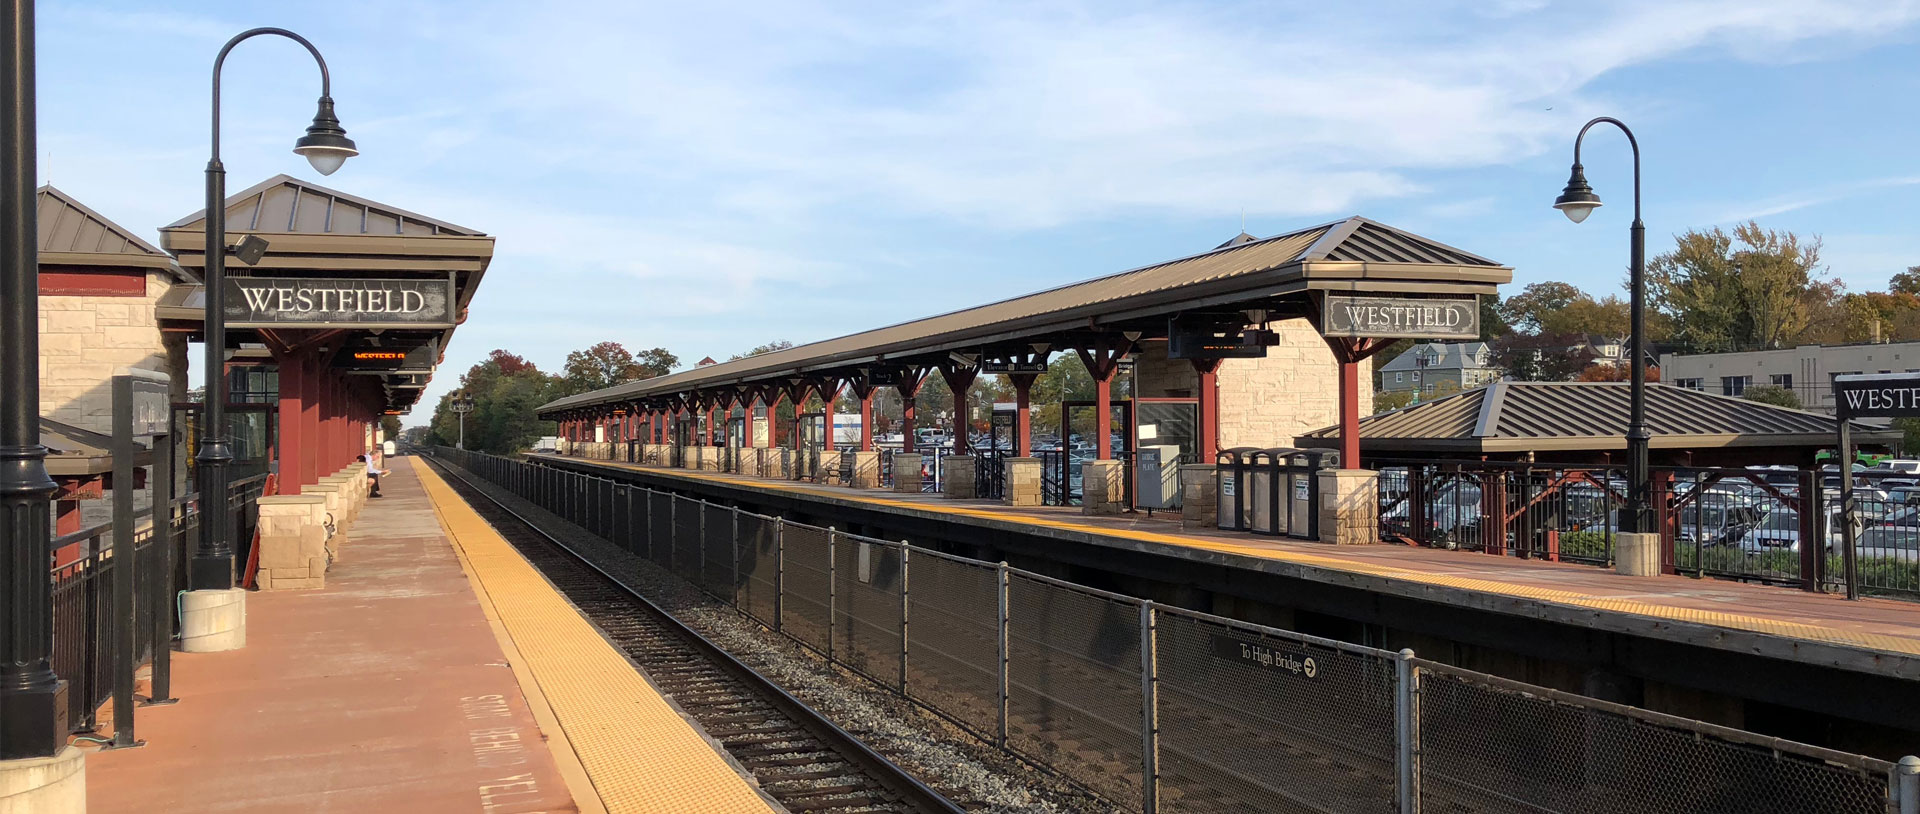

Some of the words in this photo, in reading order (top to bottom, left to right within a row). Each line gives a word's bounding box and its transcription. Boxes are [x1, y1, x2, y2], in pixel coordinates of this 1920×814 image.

[241, 287, 425, 314] WESTFIELD
[1345, 305, 1460, 327] WESTFIELD
[1240, 643, 1251, 659] To
[1252, 645, 1273, 667] High
[1275, 651, 1303, 674] Bridge
